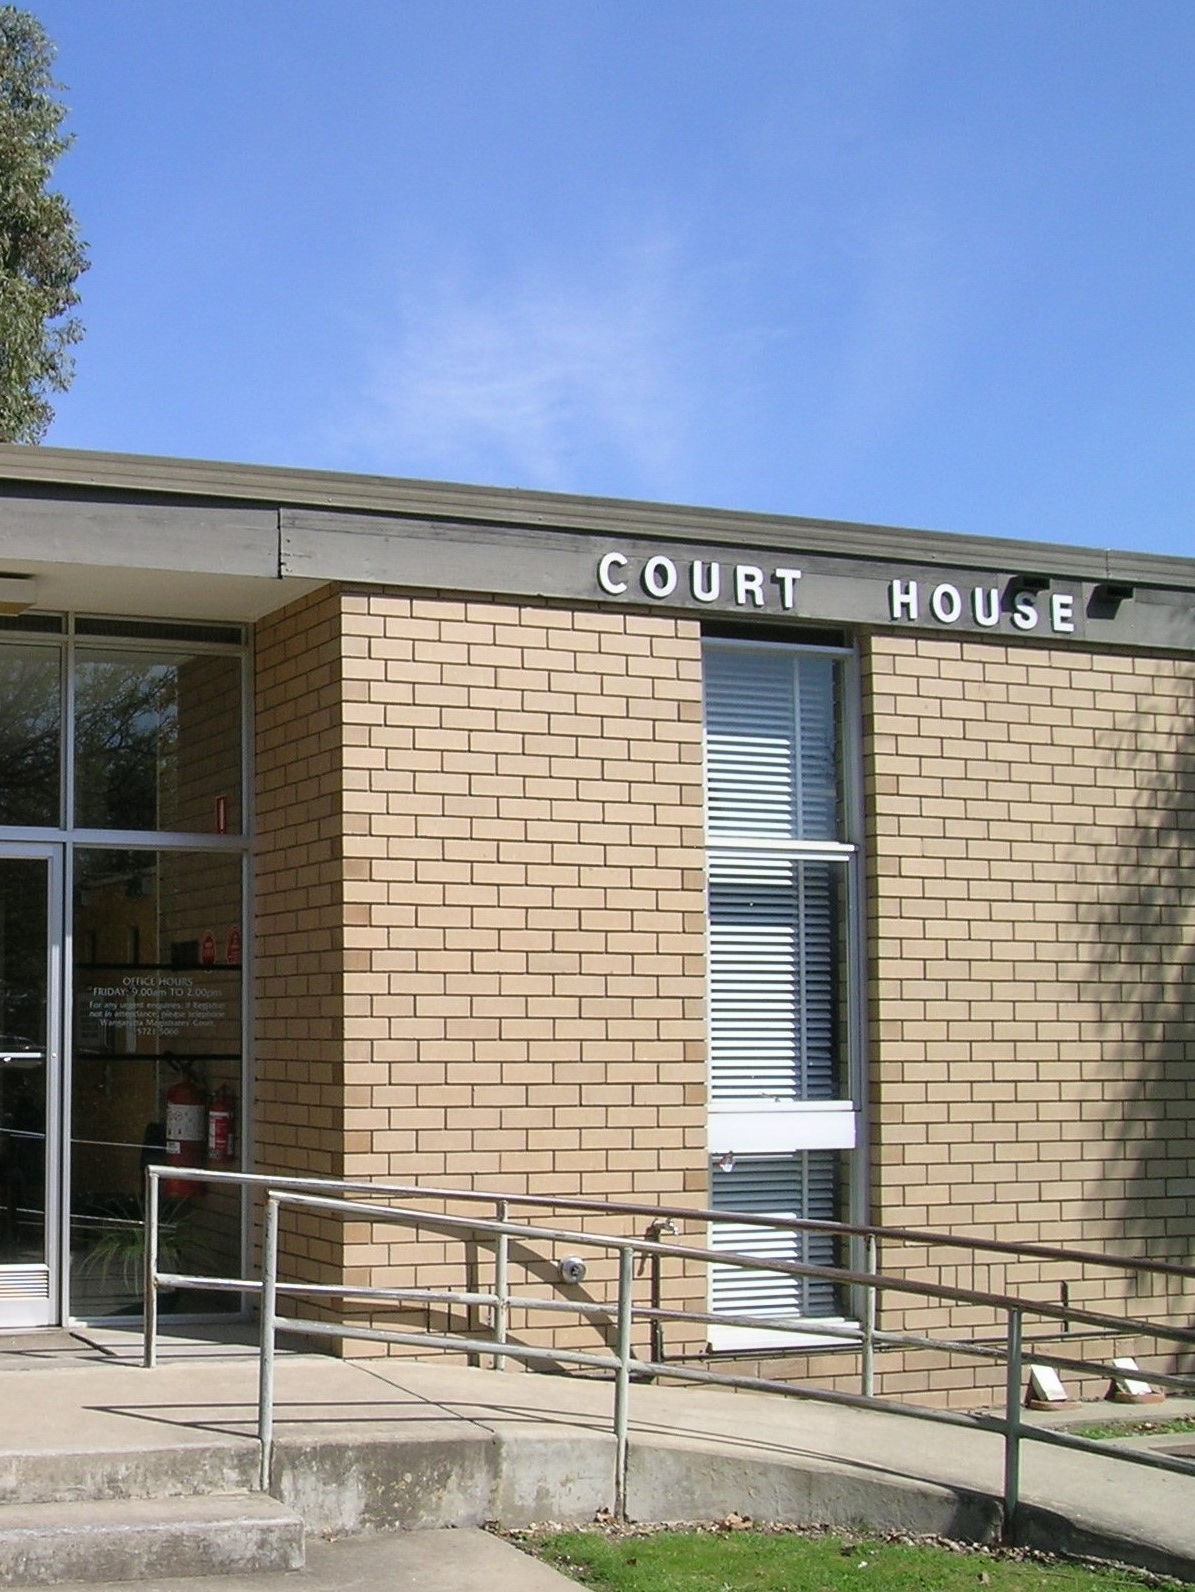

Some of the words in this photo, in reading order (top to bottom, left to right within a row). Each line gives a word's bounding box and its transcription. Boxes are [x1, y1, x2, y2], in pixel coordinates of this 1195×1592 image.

[598, 552, 802, 608] COURT
[892, 579, 1074, 633] HOUSE
[122, 976, 155, 986] OFFICE
[158, 977, 193, 986] HOURS
[170, 988, 184, 996] TO
[187, 988, 223, 998] 2.00pm
[89, 1001, 101, 1009] For
